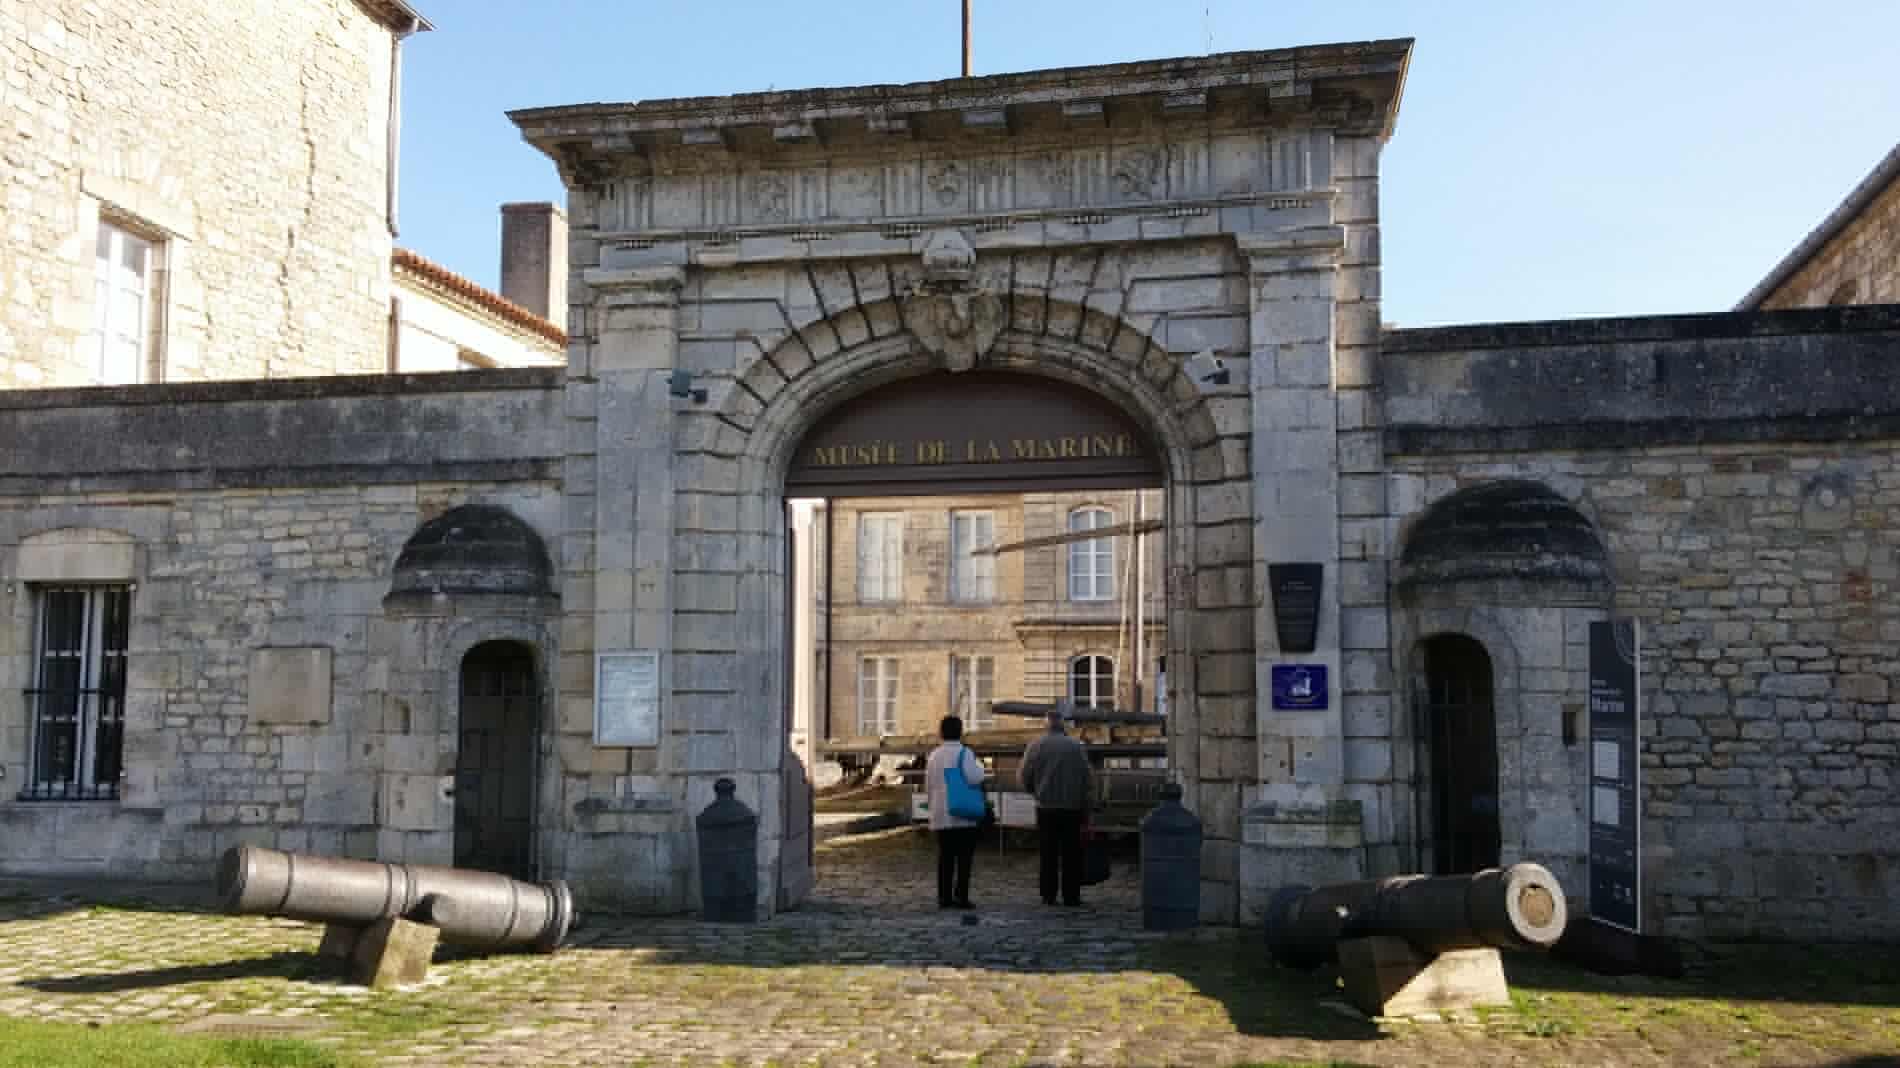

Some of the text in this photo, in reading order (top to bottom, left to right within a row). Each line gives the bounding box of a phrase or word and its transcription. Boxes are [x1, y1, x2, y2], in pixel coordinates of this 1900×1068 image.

[916, 440, 949, 464] DE
[966, 439, 1001, 463] LA
[1012, 435, 1132, 459] MARINE
